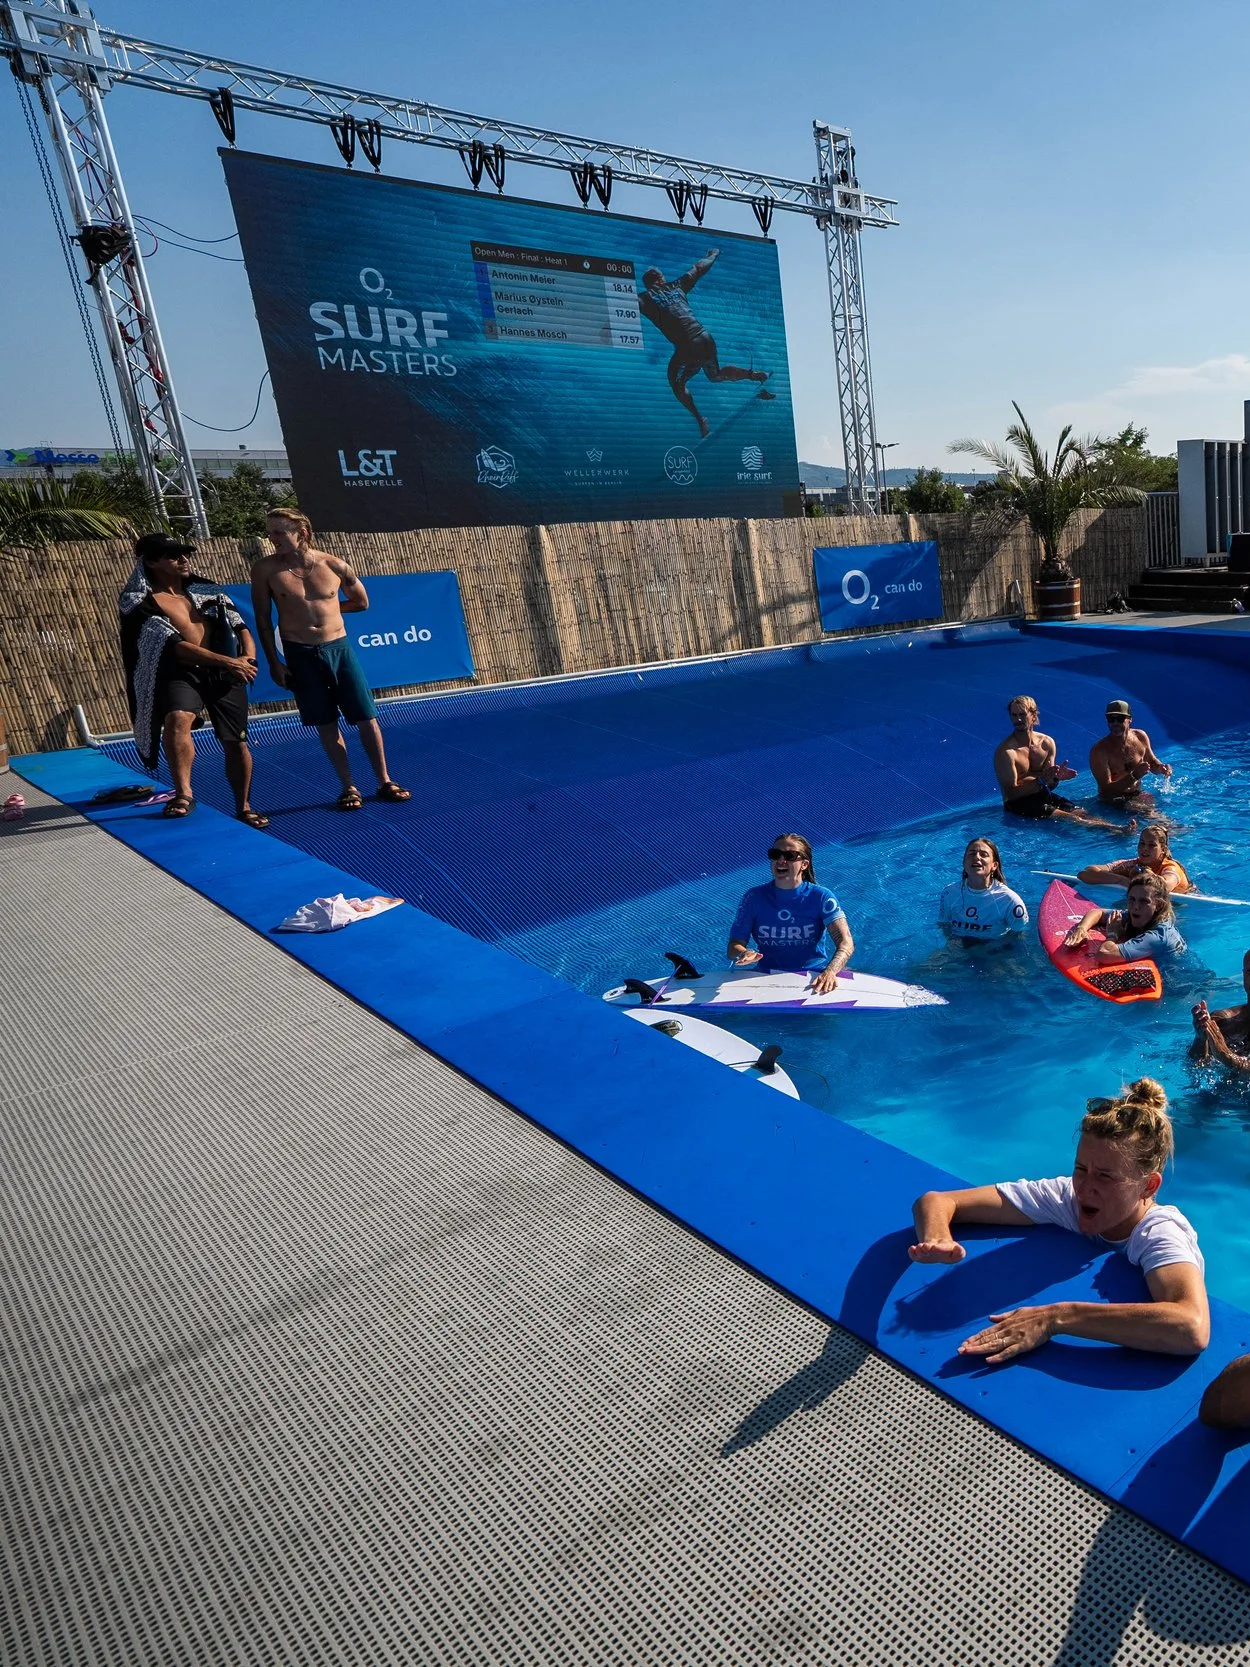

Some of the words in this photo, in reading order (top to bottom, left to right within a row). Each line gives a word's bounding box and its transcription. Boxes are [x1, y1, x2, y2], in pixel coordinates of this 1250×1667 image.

[474, 247, 497, 257] Open
[498, 250, 515, 260] Men
[521, 252, 539, 262] Final
[545, 256, 563, 265] Heat
[606, 263, 632, 274] 00:00
[491, 270, 529, 282] Antonin
[530, 274, 556, 285] Meier
[613, 283, 633, 293] 18.14
[494, 291, 527, 303] Marius
[528, 294, 564, 307] Øystein
[497, 305, 533, 316] Gerlach
[615, 309, 637, 319] 17.90
[309, 301, 449, 348] SURF
[500, 326, 535, 338] Hannes
[537, 330, 567, 340] Mosch
[619, 335, 640, 344] 17.57
[317, 346, 457, 377] MASTERS
[338, 449, 397, 477] L&T
[668, 456, 693, 469] SURF
[344, 479, 403, 487] HASEWELLE
[737, 472, 752, 480] irie
[842, 569, 880, 610] O2
[885, 583, 905, 594] can
[908, 579, 923, 592] do
[358, 631, 398, 648] can
[403, 625, 432, 643] do
[758, 924, 815, 939] SURF
